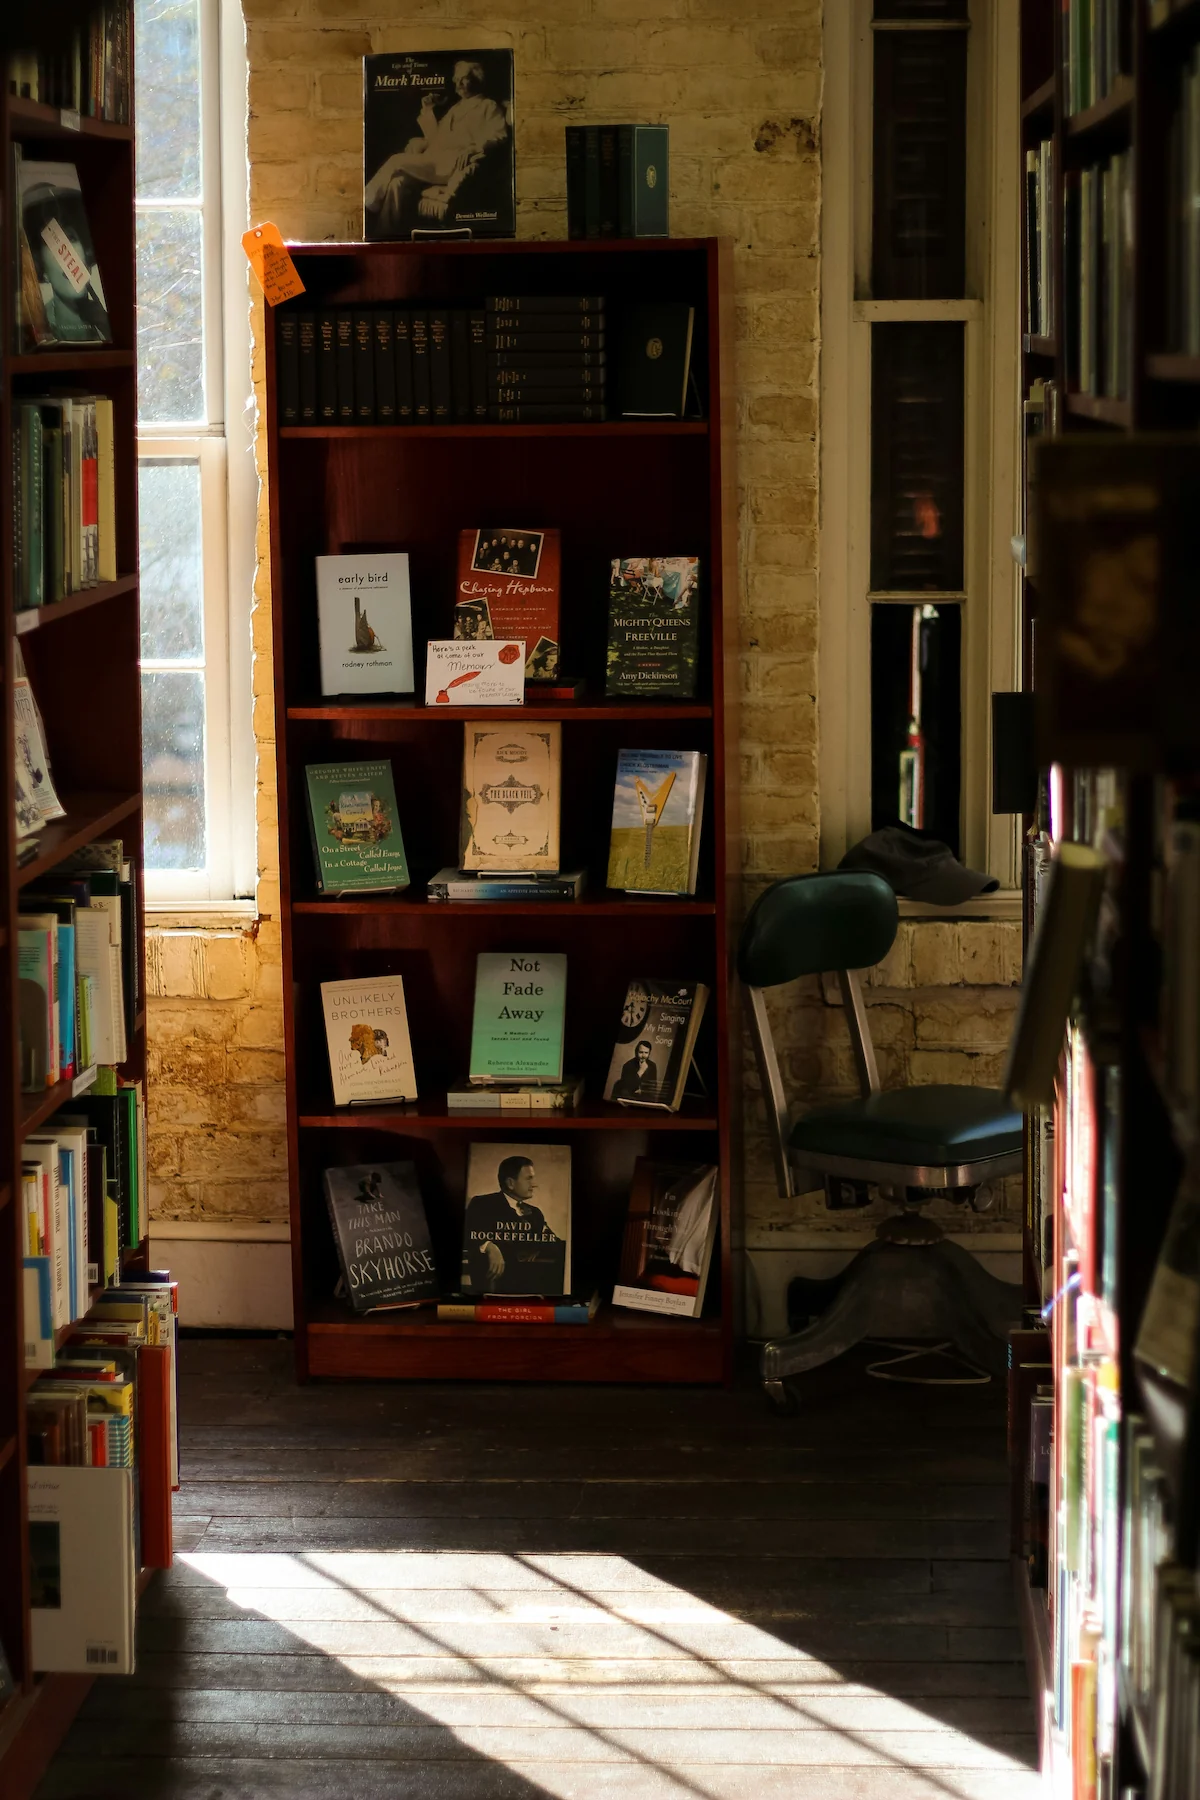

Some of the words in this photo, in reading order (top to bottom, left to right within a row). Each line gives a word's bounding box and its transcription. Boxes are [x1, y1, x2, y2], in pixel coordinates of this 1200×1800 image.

[374, 74, 408, 87] Mark
[410, 73, 445, 86] Twain
[58, 244, 84, 284] STEAL
[338, 573, 364, 585] early
[368, 572, 388, 583] bird
[460, 580, 502, 598] Chasing
[506, 580, 554, 596] Hepburn
[613, 618, 652, 627] MIGHTY
[652, 617, 691, 628] QUEENS
[625, 632, 677, 641] FREEVILLE
[342, 661, 364, 669] rodney
[619, 671, 638, 682] Amy
[638, 671, 678, 680] Dickinson
[490, 789, 501, 799] THE
[502, 789, 519, 799] BLACK
[520, 789, 532, 799] VEIL
[321, 846, 334, 854] On
[339, 844, 361, 853] Street
[359, 849, 382, 860] Called
[324, 860, 334, 868] In
[340, 859, 368, 868] Cottage
[364, 862, 387, 873] Called
[510, 958, 541, 972] Not
[502, 982, 544, 996] Fade
[333, 992, 397, 1007] UNLIKELY
[660, 994, 693, 1006] McCourt
[331, 1006, 401, 1021] BROTHERS
[498, 1005, 545, 1023] Away
[659, 1012, 686, 1025] Singing
[643, 1023, 656, 1033] My
[657, 1023, 672, 1033] Him
[654, 1035, 673, 1047] Song
[664, 1191, 677, 1201] I'm
[356, 1201, 385, 1215] TAKE
[651, 1206, 682, 1220] Looking
[348, 1216, 371, 1230] THIS
[374, 1210, 401, 1225] MAN
[496, 1221, 532, 1231] DAVID
[642, 1220, 673, 1235] Through
[470, 1230, 557, 1242] ROCKEFELLER
[355, 1231, 414, 1258] BRANDO
[349, 1249, 437, 1289] SKYHORSE
[619, 1290, 643, 1301] Jennifer
[644, 1294, 665, 1304] Finney
[665, 1295, 687, 1307] Boylan
